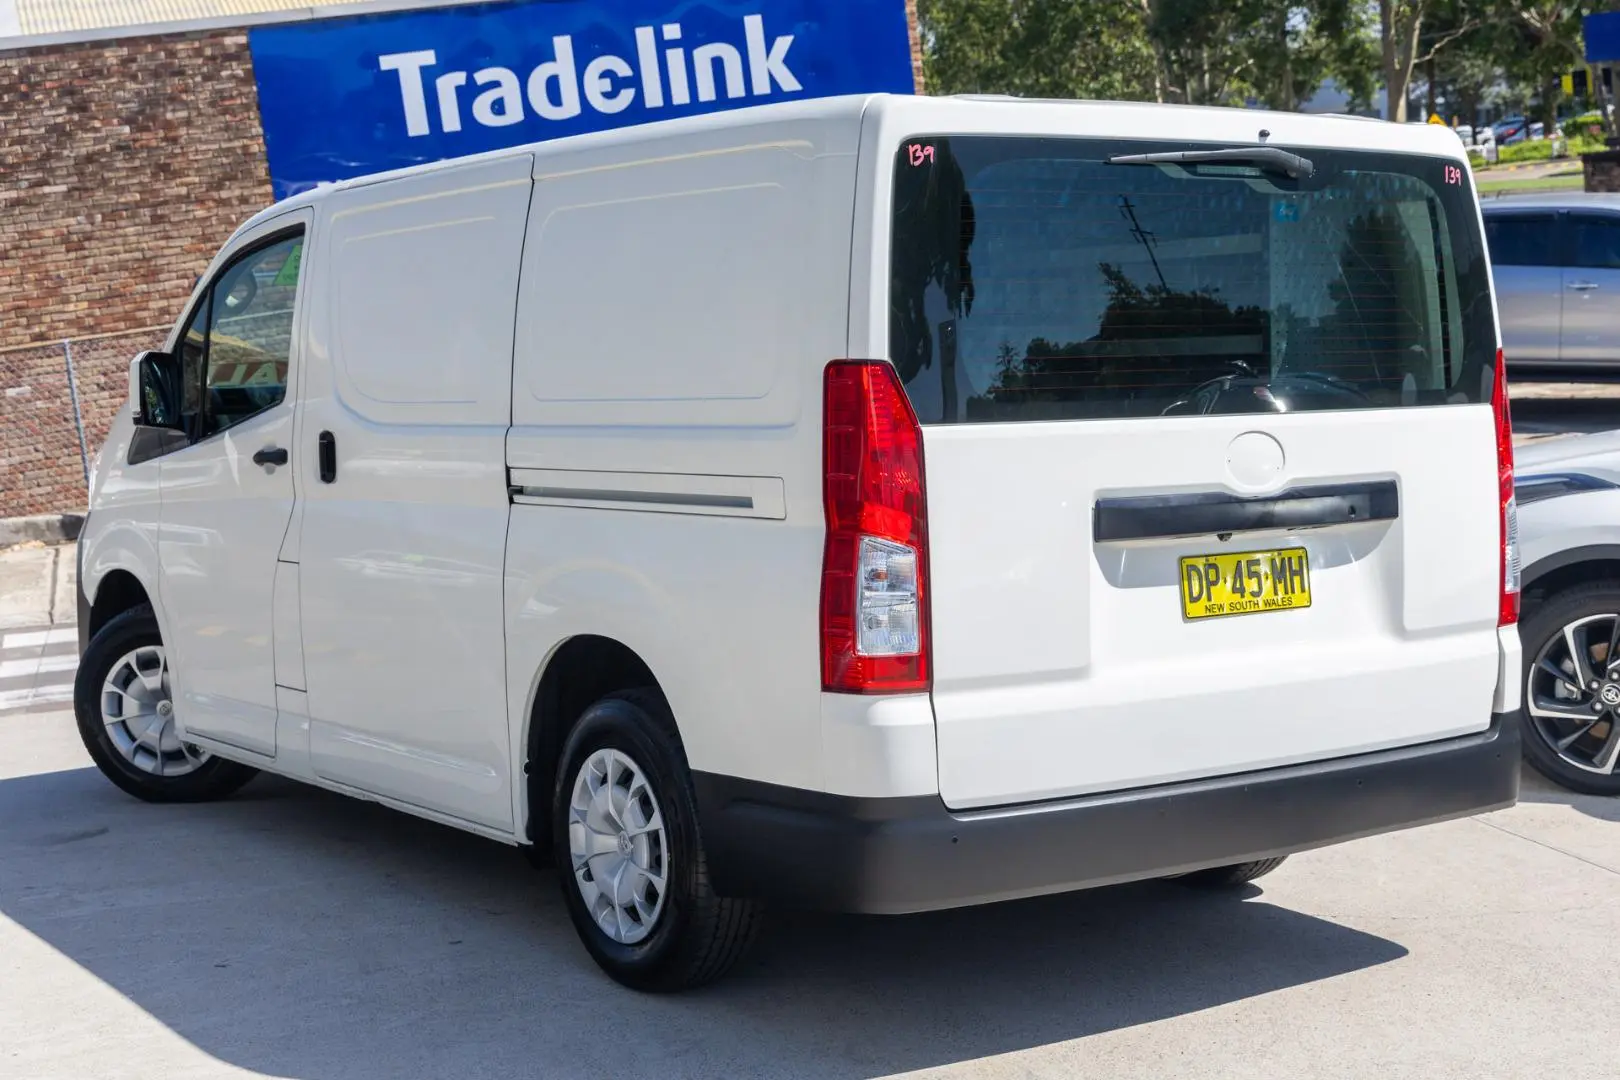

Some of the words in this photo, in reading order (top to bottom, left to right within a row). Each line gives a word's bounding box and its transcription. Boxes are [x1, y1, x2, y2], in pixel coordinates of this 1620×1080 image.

[378, 13, 803, 137] Tradelink
[908, 143, 935, 167] 139
[1444, 164, 1462, 187] 139
[1204, 602, 1225, 614] NEW
[1229, 601, 1260, 612] SOUTH
[1263, 596, 1293, 607] WALES
